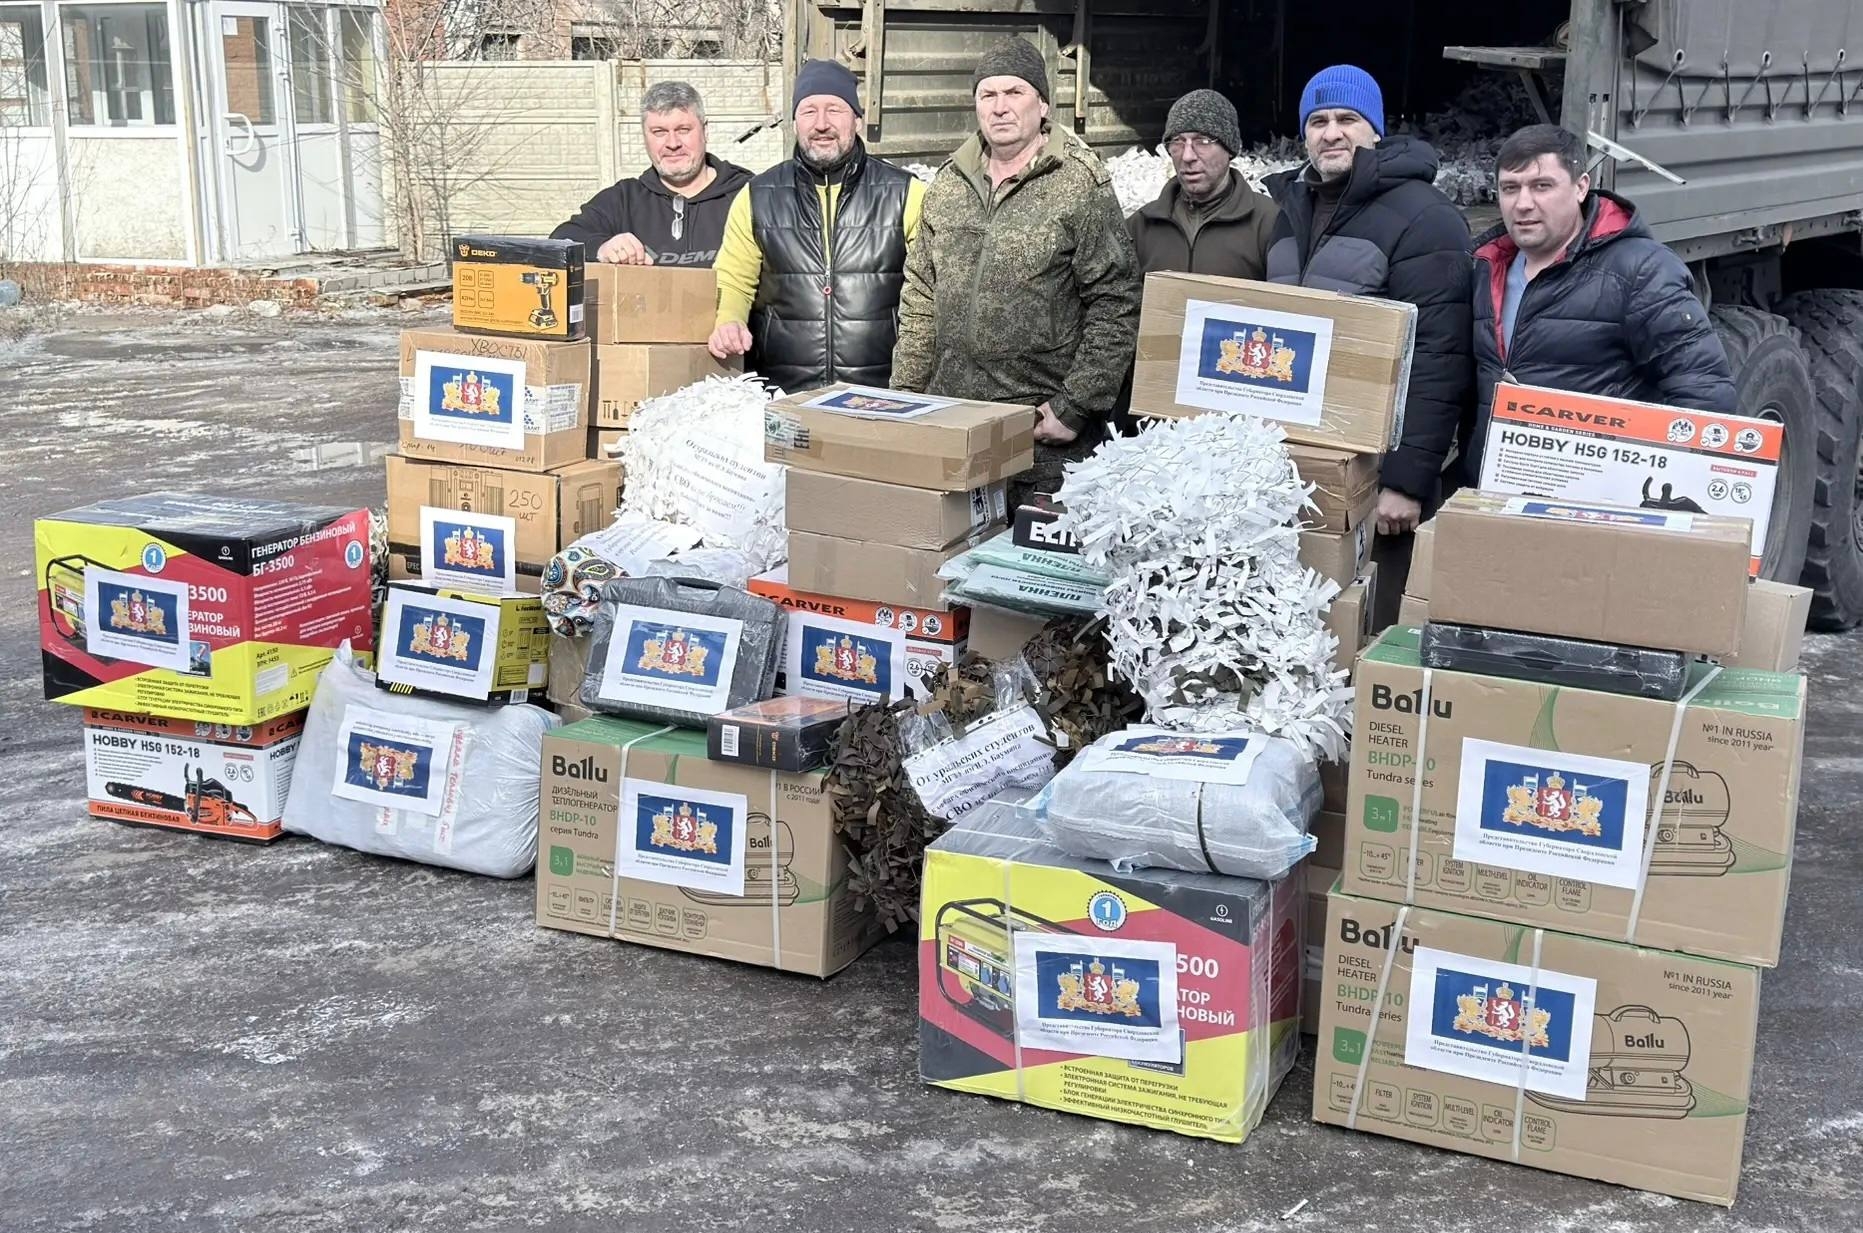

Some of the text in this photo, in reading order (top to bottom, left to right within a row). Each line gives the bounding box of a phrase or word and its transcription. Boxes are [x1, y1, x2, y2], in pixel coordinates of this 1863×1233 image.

[471, 249, 496, 258] DEKO
[1521, 404, 1626, 428] CARVER
[1501, 430, 1668, 469] HOBBY HSG 152-18
[509, 489, 543, 510] 250
[251, 521, 356, 558] ГЕНЕРАТОР БЕНЗИНОВЫЙ
[253, 555, 295, 577] БГ-3500
[1022, 552, 1081, 573] ПЛЕНКА
[1019, 586, 1081, 601] ПЛЕНКА
[100, 713, 169, 728] CARVER
[1369, 722, 1404, 735] DIESEL
[985, 723, 1035, 753] студентов
[1368, 734, 1409, 748] HEATER
[1722, 727, 1733, 736] IN
[1736, 728, 1773, 742] RUSSIA
[93, 734, 200, 758] HOBBY HSG 152-18
[270, 743, 296, 761] HOBBY
[1707, 736, 1774, 751] since 2011 year
[552, 755, 608, 783] Ballu
[1368, 751, 1436, 771] BHDP-0
[1367, 769, 1434, 788] Tundra sees
[552, 785, 598, 800] ДИЗЕЛЬНЫЙ
[790, 784, 821, 796] РОССИИ
[552, 796, 618, 813] ТЕПЛОГЕНЕРАТОР
[97, 805, 180, 823] ПИЛА ЦЕПНАЯ БЕНЗИНОВАЯ
[550, 810, 596, 826] BHDP-10
[550, 826, 598, 840] серия Tundra
[1517, 880, 1548, 891] INDICATOR
[1102, 901, 1111, 918] 1
[1341, 918, 1420, 954] Balu
[1176, 953, 1219, 978] 500
[1338, 955, 1372, 969] DIESEL
[1337, 967, 1377, 982] HEATER
[1683, 973, 1693, 983] IN
[1696, 976, 1732, 990] RUSSIA
[1337, 984, 1404, 1006] BHDP10
[1668, 982, 1733, 999] since 2011 year
[1336, 1001, 1402, 1022] Tundra eries
[1624, 1033, 1665, 1049] Ballu
[1488, 1050, 1521, 1062] Губернатор
[1529, 1060, 1565, 1071] вердловской
[1498, 1058, 1530, 1070] Российскй
[1064, 1065, 1103, 1077] ВСТРОЕННАЯ
[1105, 1072, 1130, 1083] ЗАЩИТА
[1140, 1078, 1178, 1091] ПЕРЕГРУЗКИ
[1064, 1081, 1107, 1093] РЕГУЛИРОВКИ
[1064, 1073, 1107, 1086] ЭЛЕКТРОННАЯ
[1108, 1081, 1137, 1092] СИСТЕМА
[1188, 1095, 1228, 1109] ТРЕБУЮЩАЯ
[1376, 1089, 1392, 1099] FILTER
[1063, 1088, 1080, 1097] БЛОК
[1080, 1092, 1116, 1104] ГЕНЕРАЦИИ
[1117, 1098, 1167, 1114] ЭЛЕКТРИЧЕСТВА
[1168, 1107, 1213, 1123] СИНХРОННОГО
[1063, 1096, 1208, 1130] ЭФФЕКТИВНЫЙ НИЗКОЧАСТОТНЫЙ ГЛУШИТЕЛЬ
[1524, 1117, 1552, 1129] CONTROL
[1527, 1124, 1546, 1135] FLAME
